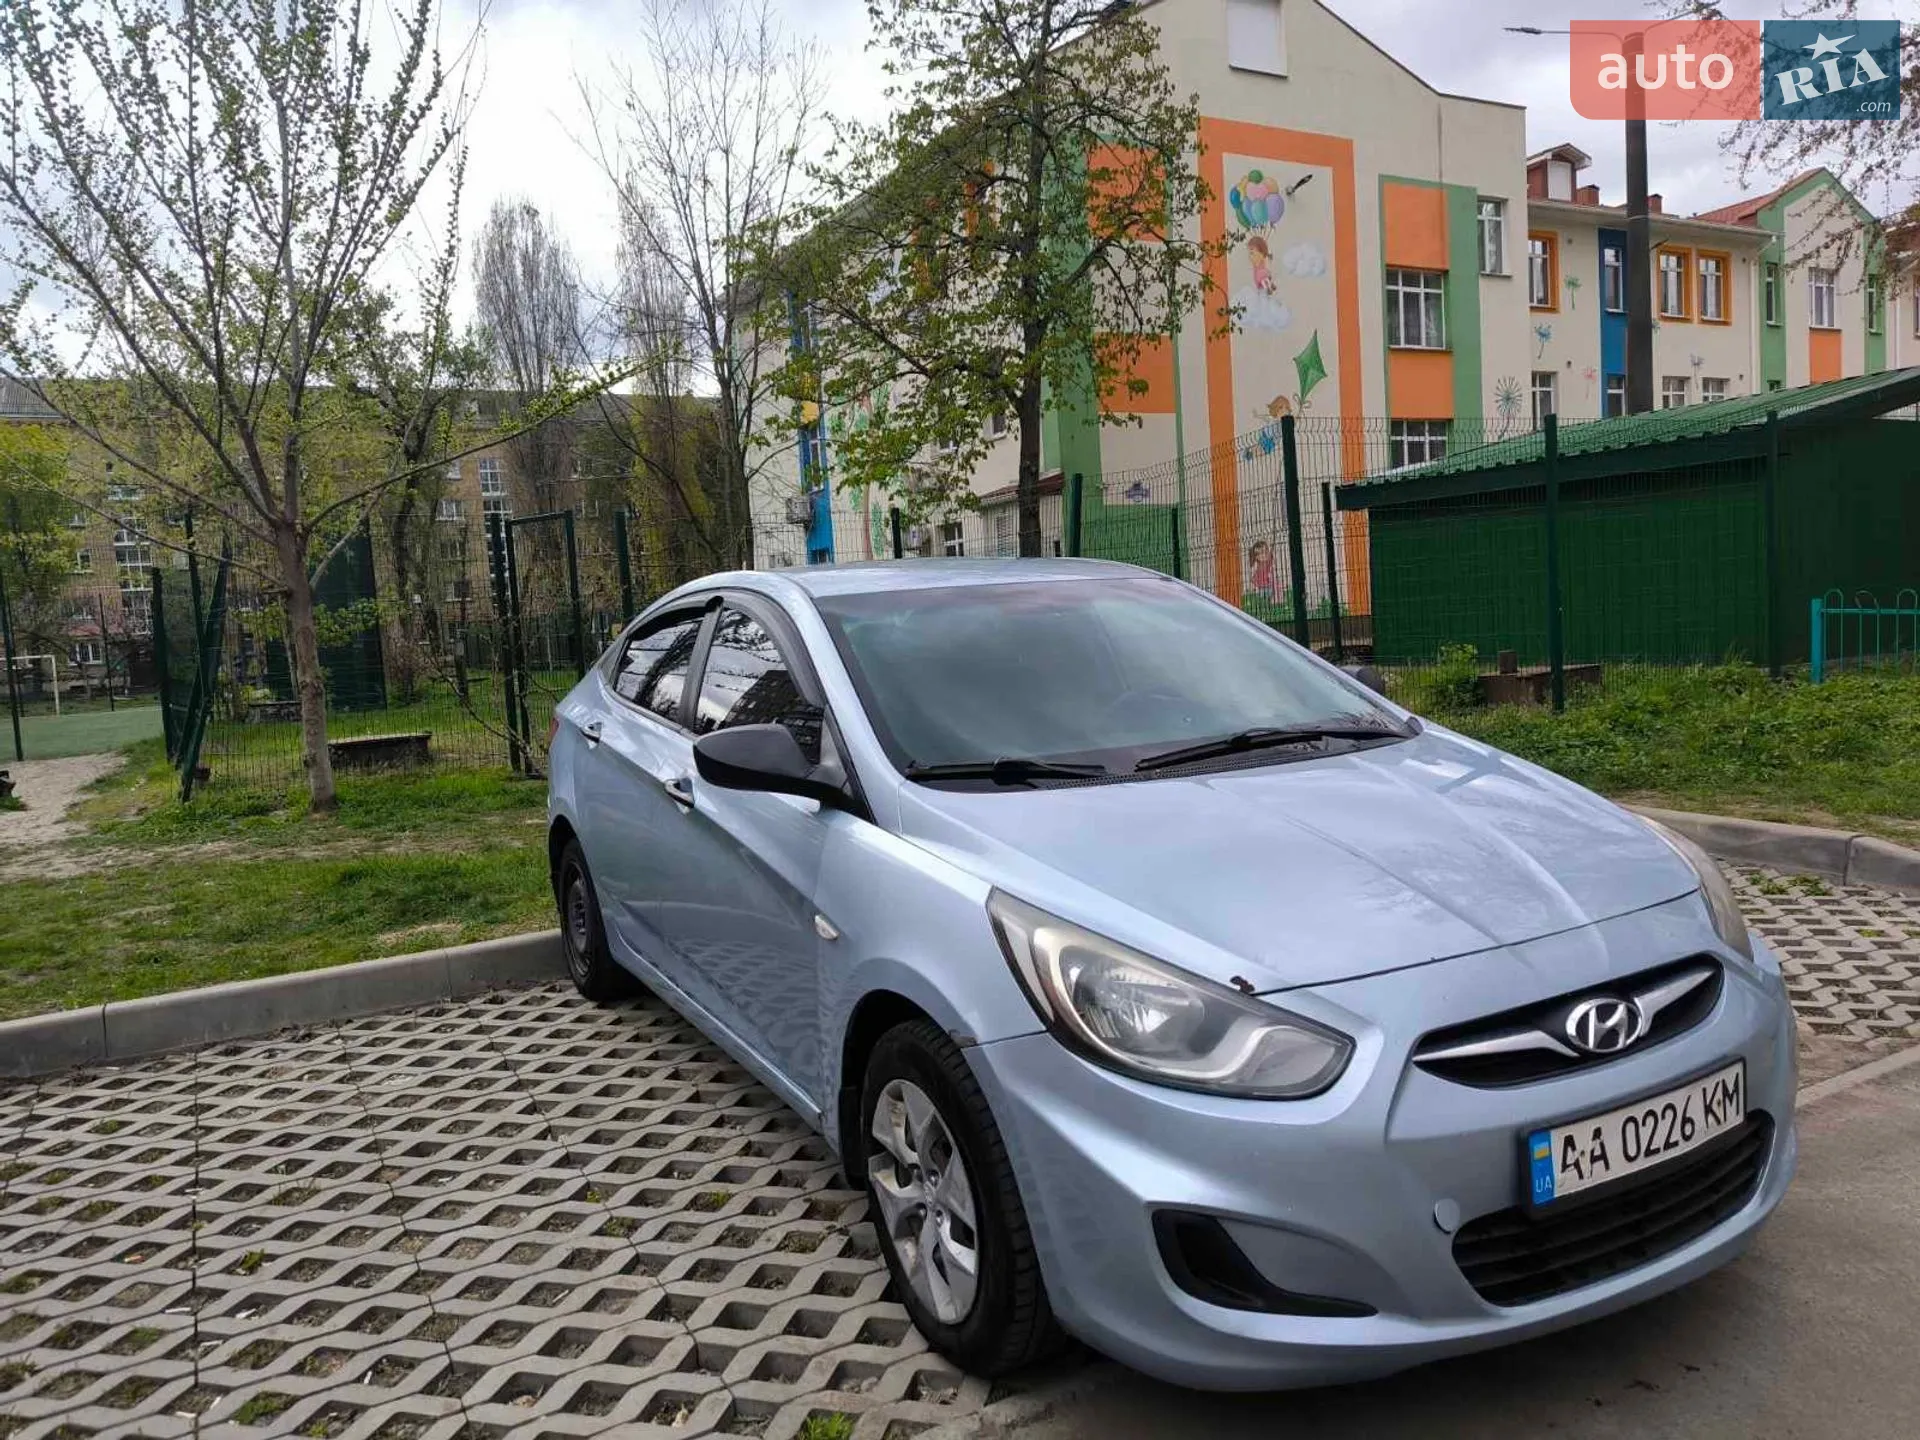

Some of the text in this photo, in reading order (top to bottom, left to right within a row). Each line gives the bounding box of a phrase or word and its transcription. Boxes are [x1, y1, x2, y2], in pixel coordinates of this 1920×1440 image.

[1561, 1073, 1740, 1180] AA 0226 KM
[1535, 1175, 1552, 1193] UA
